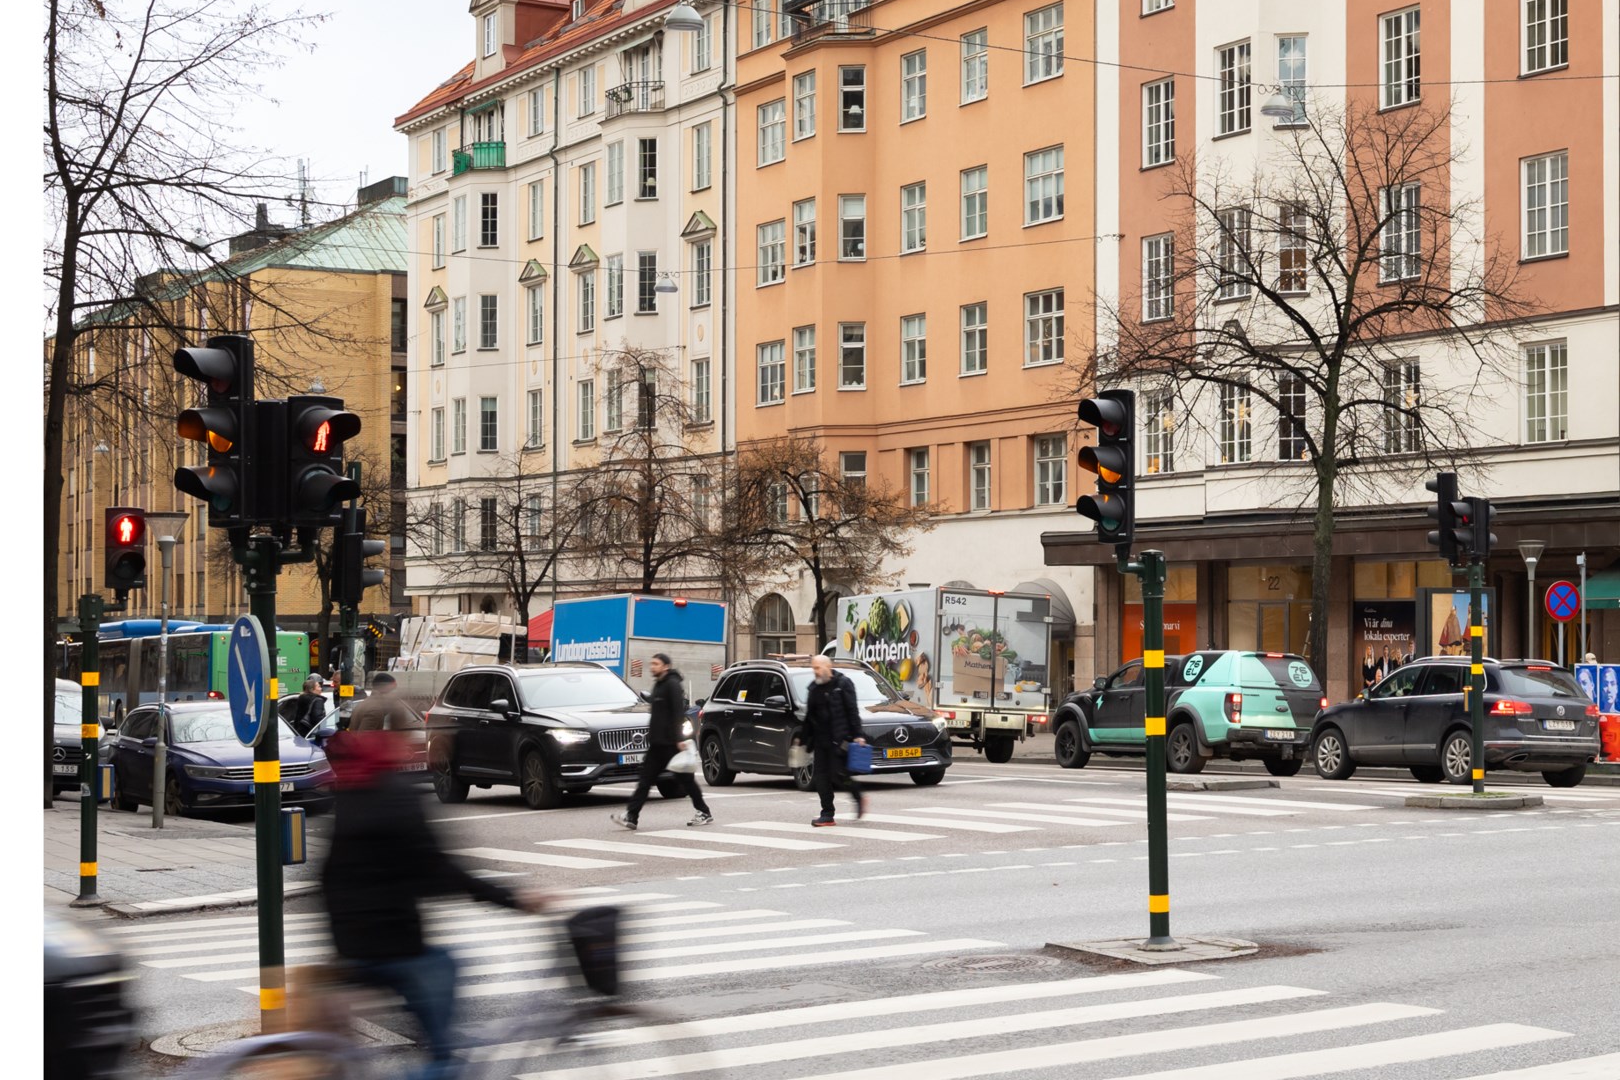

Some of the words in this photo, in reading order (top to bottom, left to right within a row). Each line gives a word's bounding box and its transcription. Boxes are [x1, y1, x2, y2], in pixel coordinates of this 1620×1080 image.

[1268, 576, 1280, 590] 22
[945, 596, 967, 605] R542
[1364, 618, 1372, 628] Vi
[1372, 618, 1379, 628] är
[1380, 618, 1393, 628] dina
[1364, 630, 1383, 640] lokala
[1383, 633, 1411, 644] experter
[853, 638, 912, 662] Mathem
[1189, 660, 1201, 668] 76
[1185, 668, 1197, 676] EL
[1290, 666, 1308, 674] 76
[1293, 674, 1310, 682] EL
[625, 754, 639, 762] HNL
